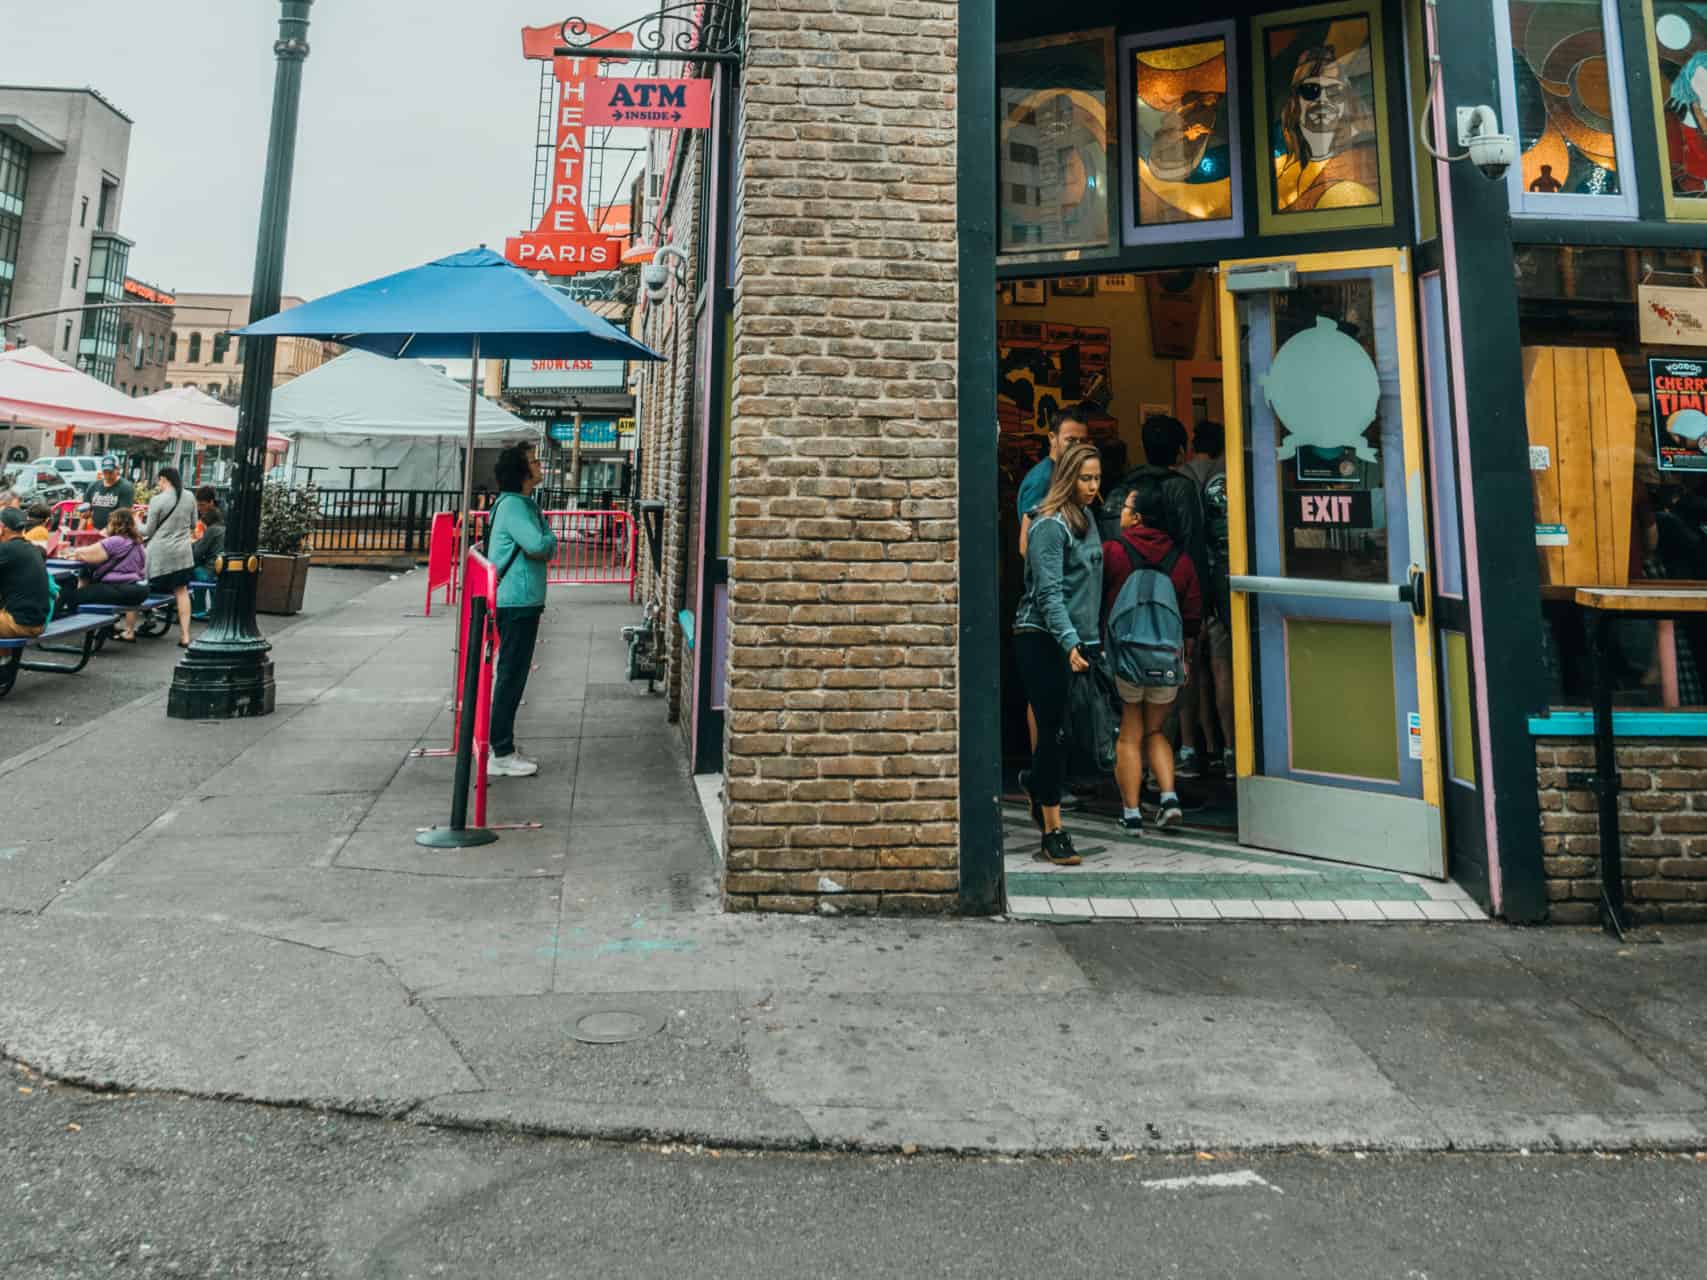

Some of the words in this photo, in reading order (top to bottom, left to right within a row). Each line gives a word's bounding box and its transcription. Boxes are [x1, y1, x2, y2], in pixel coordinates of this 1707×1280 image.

[608, 83, 686, 108] ATM
[624, 111, 671, 121] INSIDE
[554, 56, 584, 231] THEATRE
[518, 244, 607, 263] PARIS
[531, 359, 592, 370] SHOWCASE
[620, 421, 636, 429] ATM
[1301, 495, 1352, 522] EXIT
